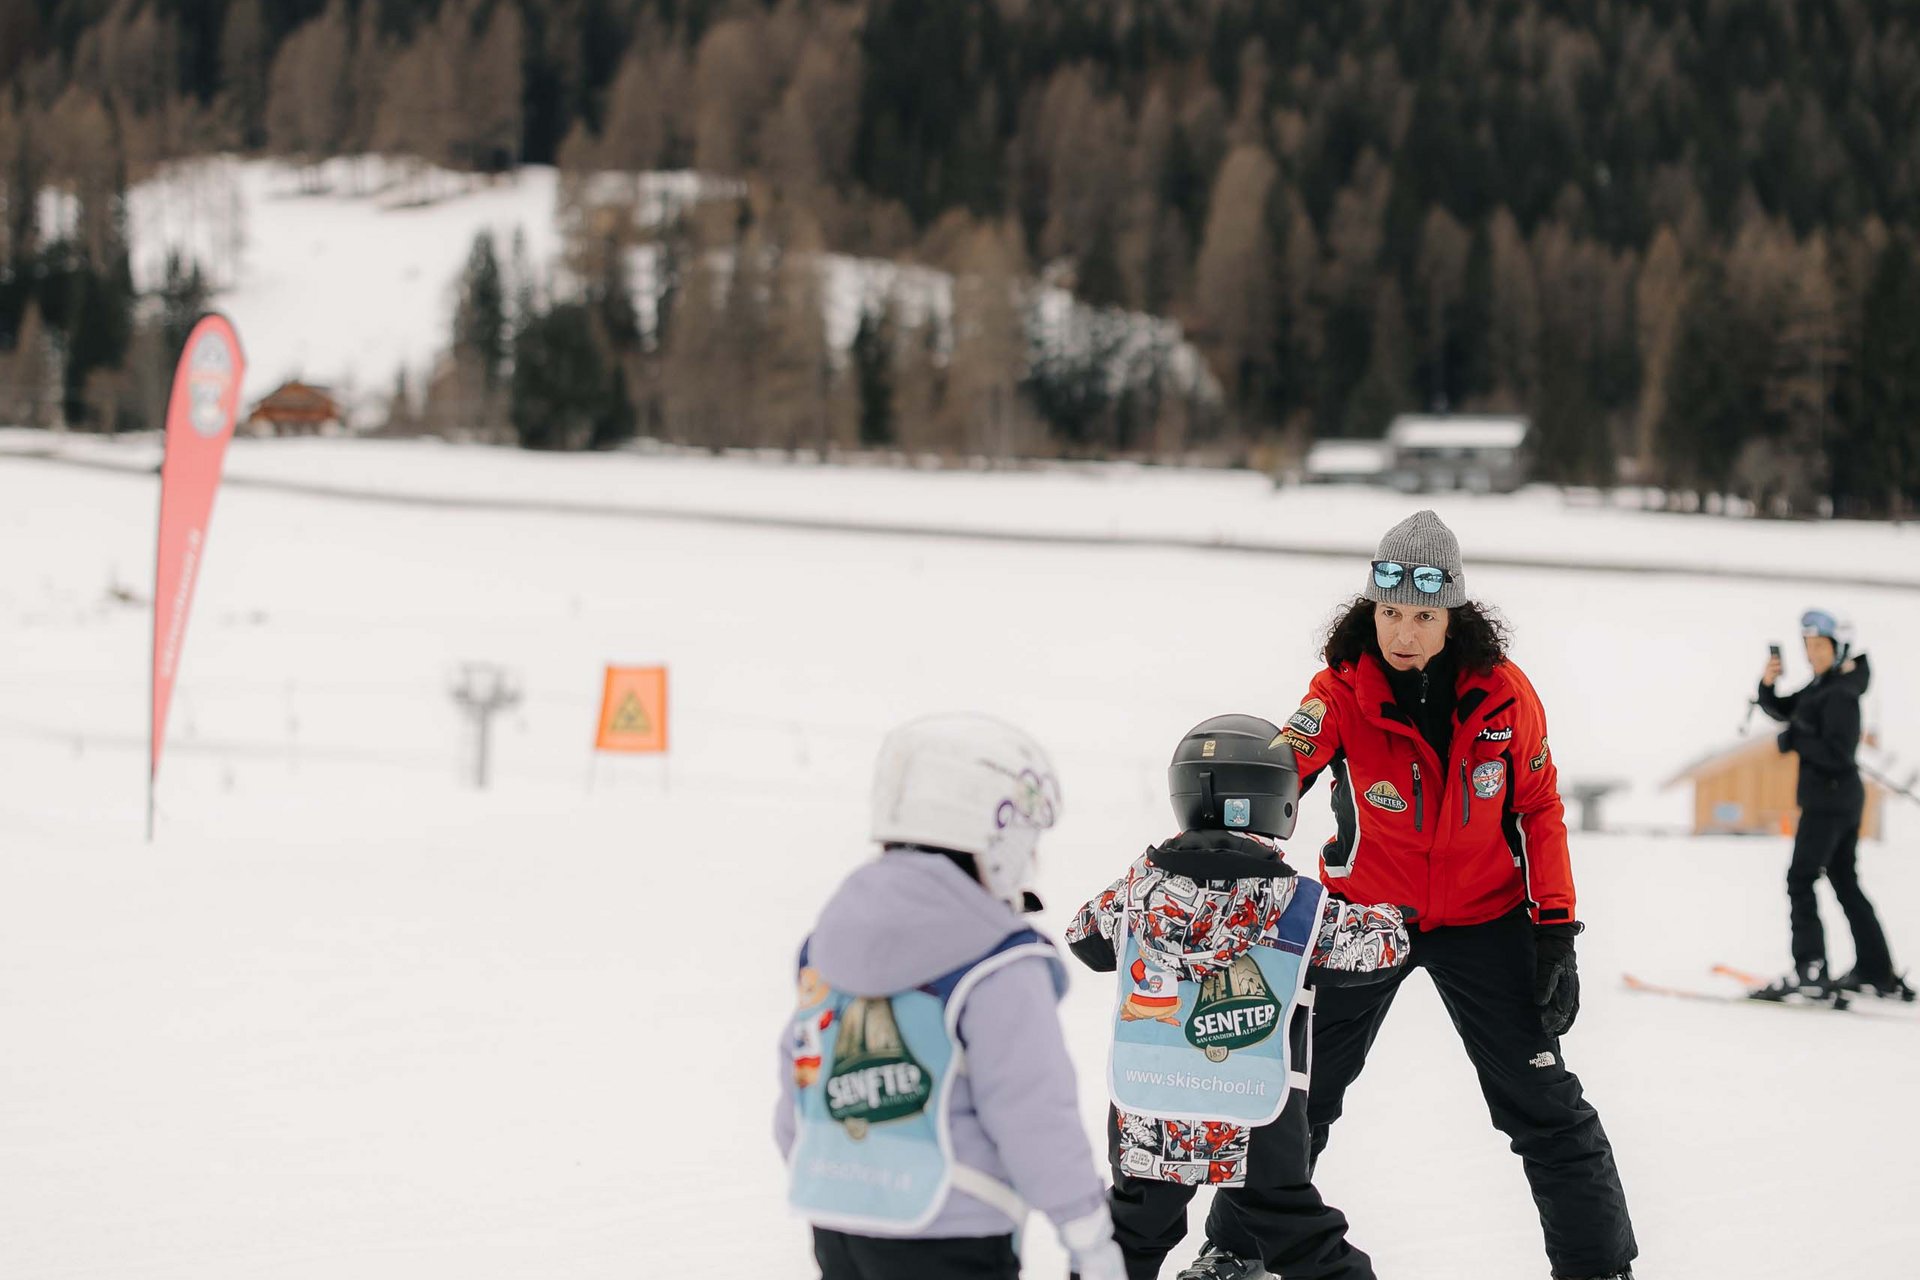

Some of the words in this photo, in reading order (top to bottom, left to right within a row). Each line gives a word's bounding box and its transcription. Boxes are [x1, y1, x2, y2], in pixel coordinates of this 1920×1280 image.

[1368, 793, 1402, 808] SENFTER
[1193, 1004, 1276, 1037] SENFTER
[1208, 1031, 1235, 1042] CANDIDO
[1208, 1047, 1226, 1059] 1857
[1126, 1069, 1265, 1096] www.skischool.it
